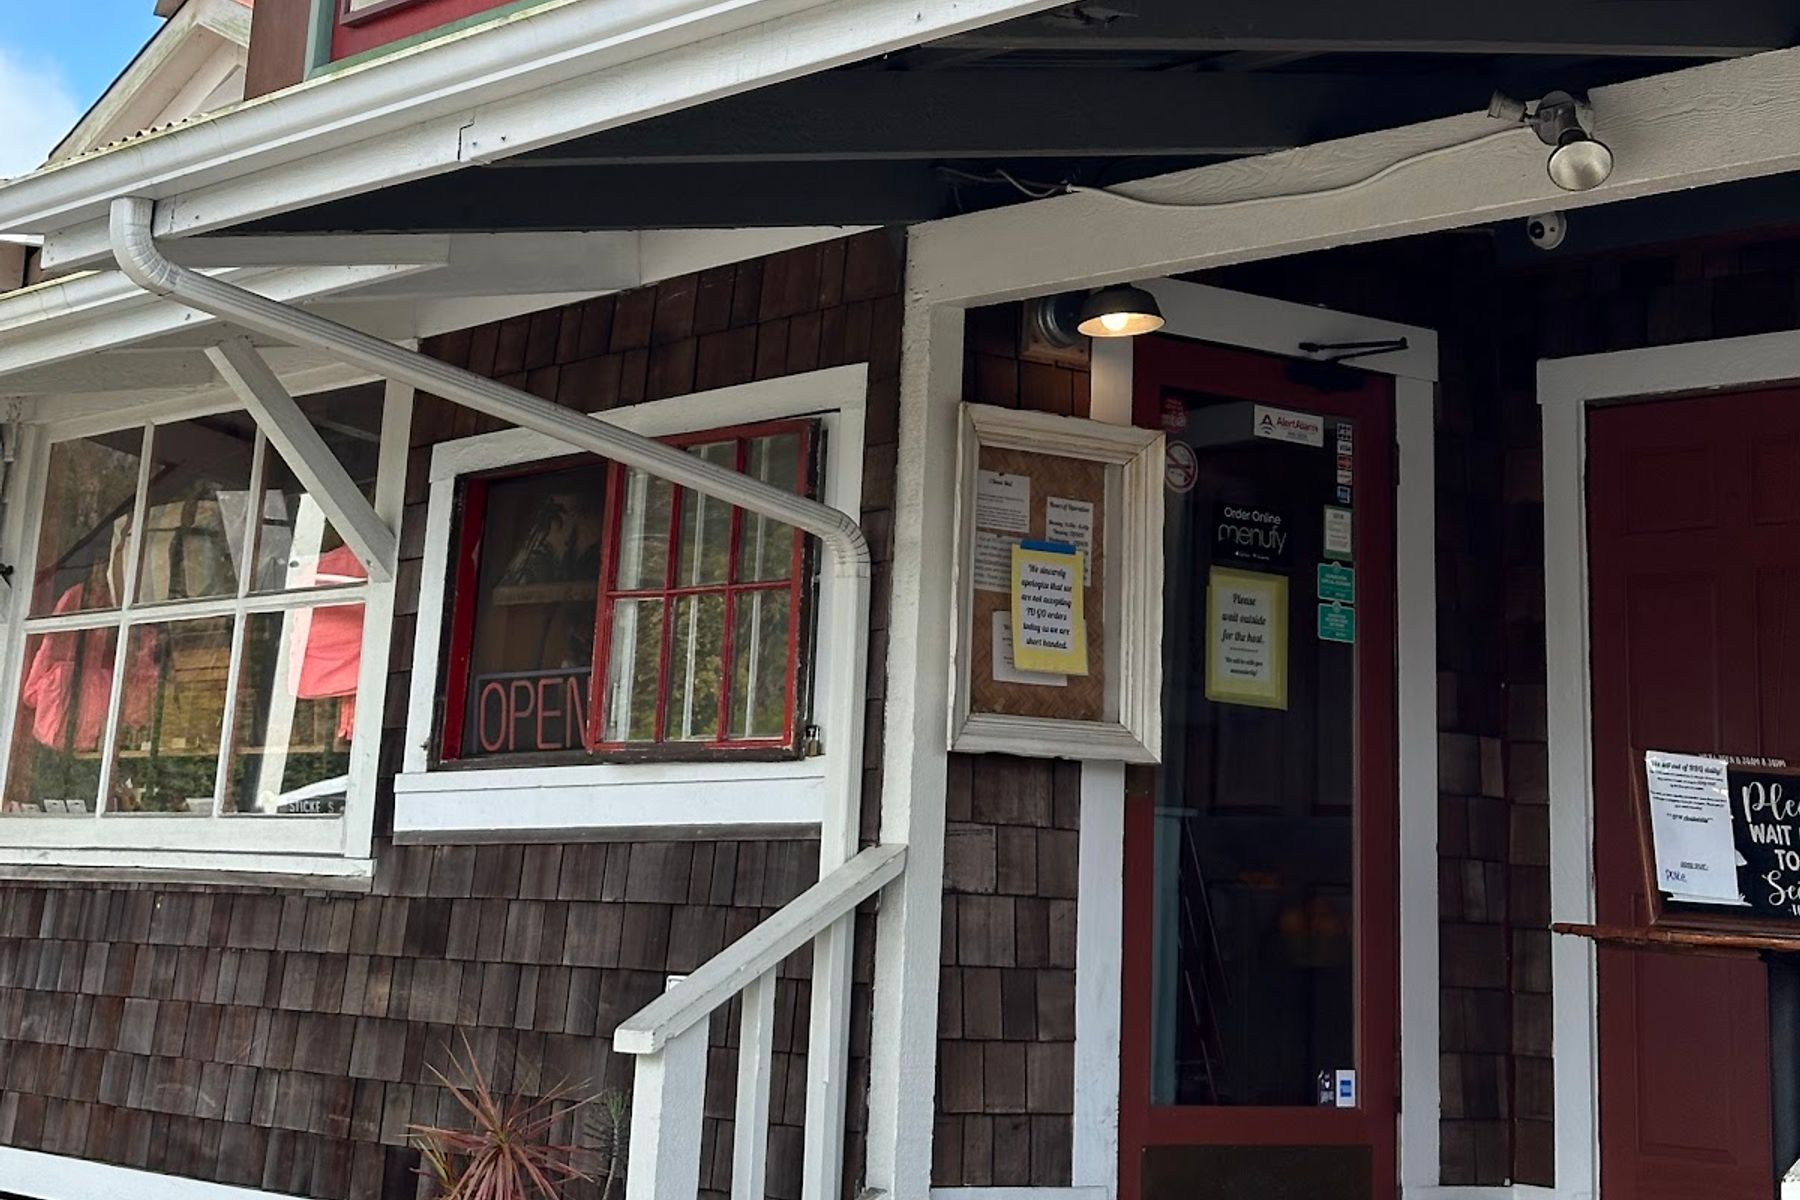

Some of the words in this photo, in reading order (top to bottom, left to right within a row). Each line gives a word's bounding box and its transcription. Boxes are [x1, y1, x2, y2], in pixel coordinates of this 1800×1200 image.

[1224, 506, 1250, 520] Order
[1252, 510, 1281, 524] Online
[1232, 593, 1256, 606] Please
[1222, 613, 1238, 622] wait
[1239, 614, 1267, 625] outside
[1221, 628, 1233, 642] for
[1234, 631, 1246, 642] the
[480, 676, 589, 752] OPEN
[289, 799, 335, 814] STICKES
[1742, 781, 1800, 823] Ple
[1749, 823, 1792, 846] WAIT
[1774, 849, 1800, 871] TO
